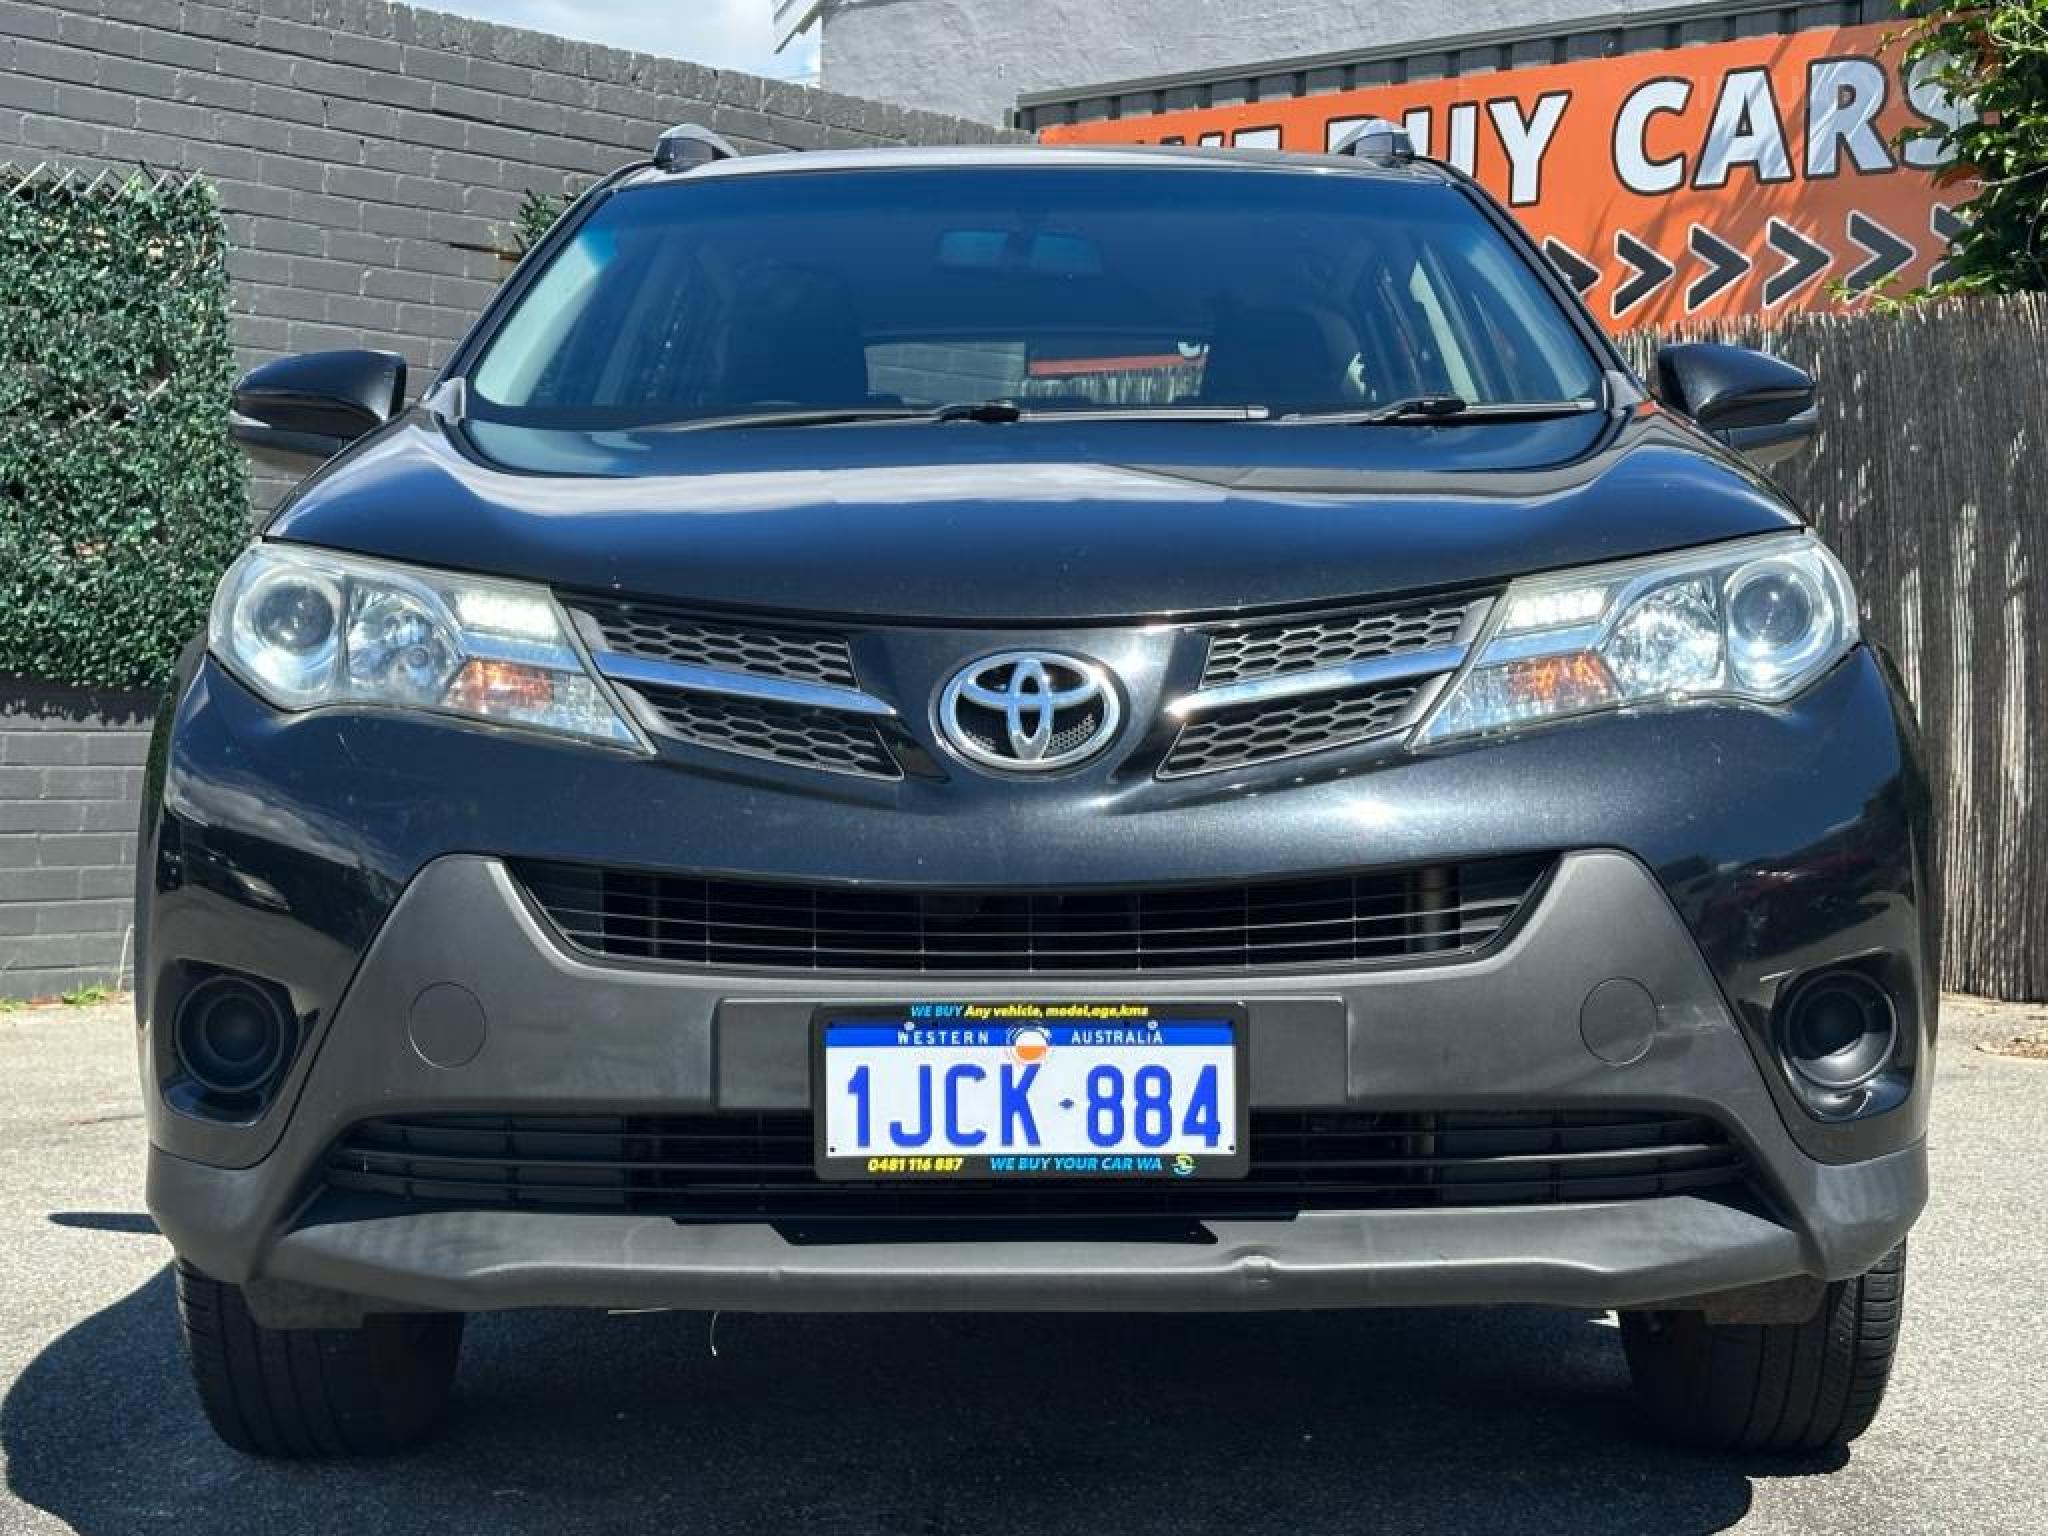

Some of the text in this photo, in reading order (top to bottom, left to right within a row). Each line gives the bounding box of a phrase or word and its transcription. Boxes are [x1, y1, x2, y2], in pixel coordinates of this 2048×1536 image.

[1326, 50, 1981, 208] UY CARS
[911, 1005, 932, 1017] WE
[935, 1005, 963, 1017] BUY
[964, 1004, 991, 1019] Any
[897, 1030, 1163, 1045] WESTERN AUSTRALIA
[991, 1157, 1016, 1171] WE
[1019, 1157, 1050, 1171] BUY
[1054, 1157, 1098, 1171] YOUR
[1101, 1157, 1133, 1171] CAR
[1137, 1157, 1163, 1171] WA
